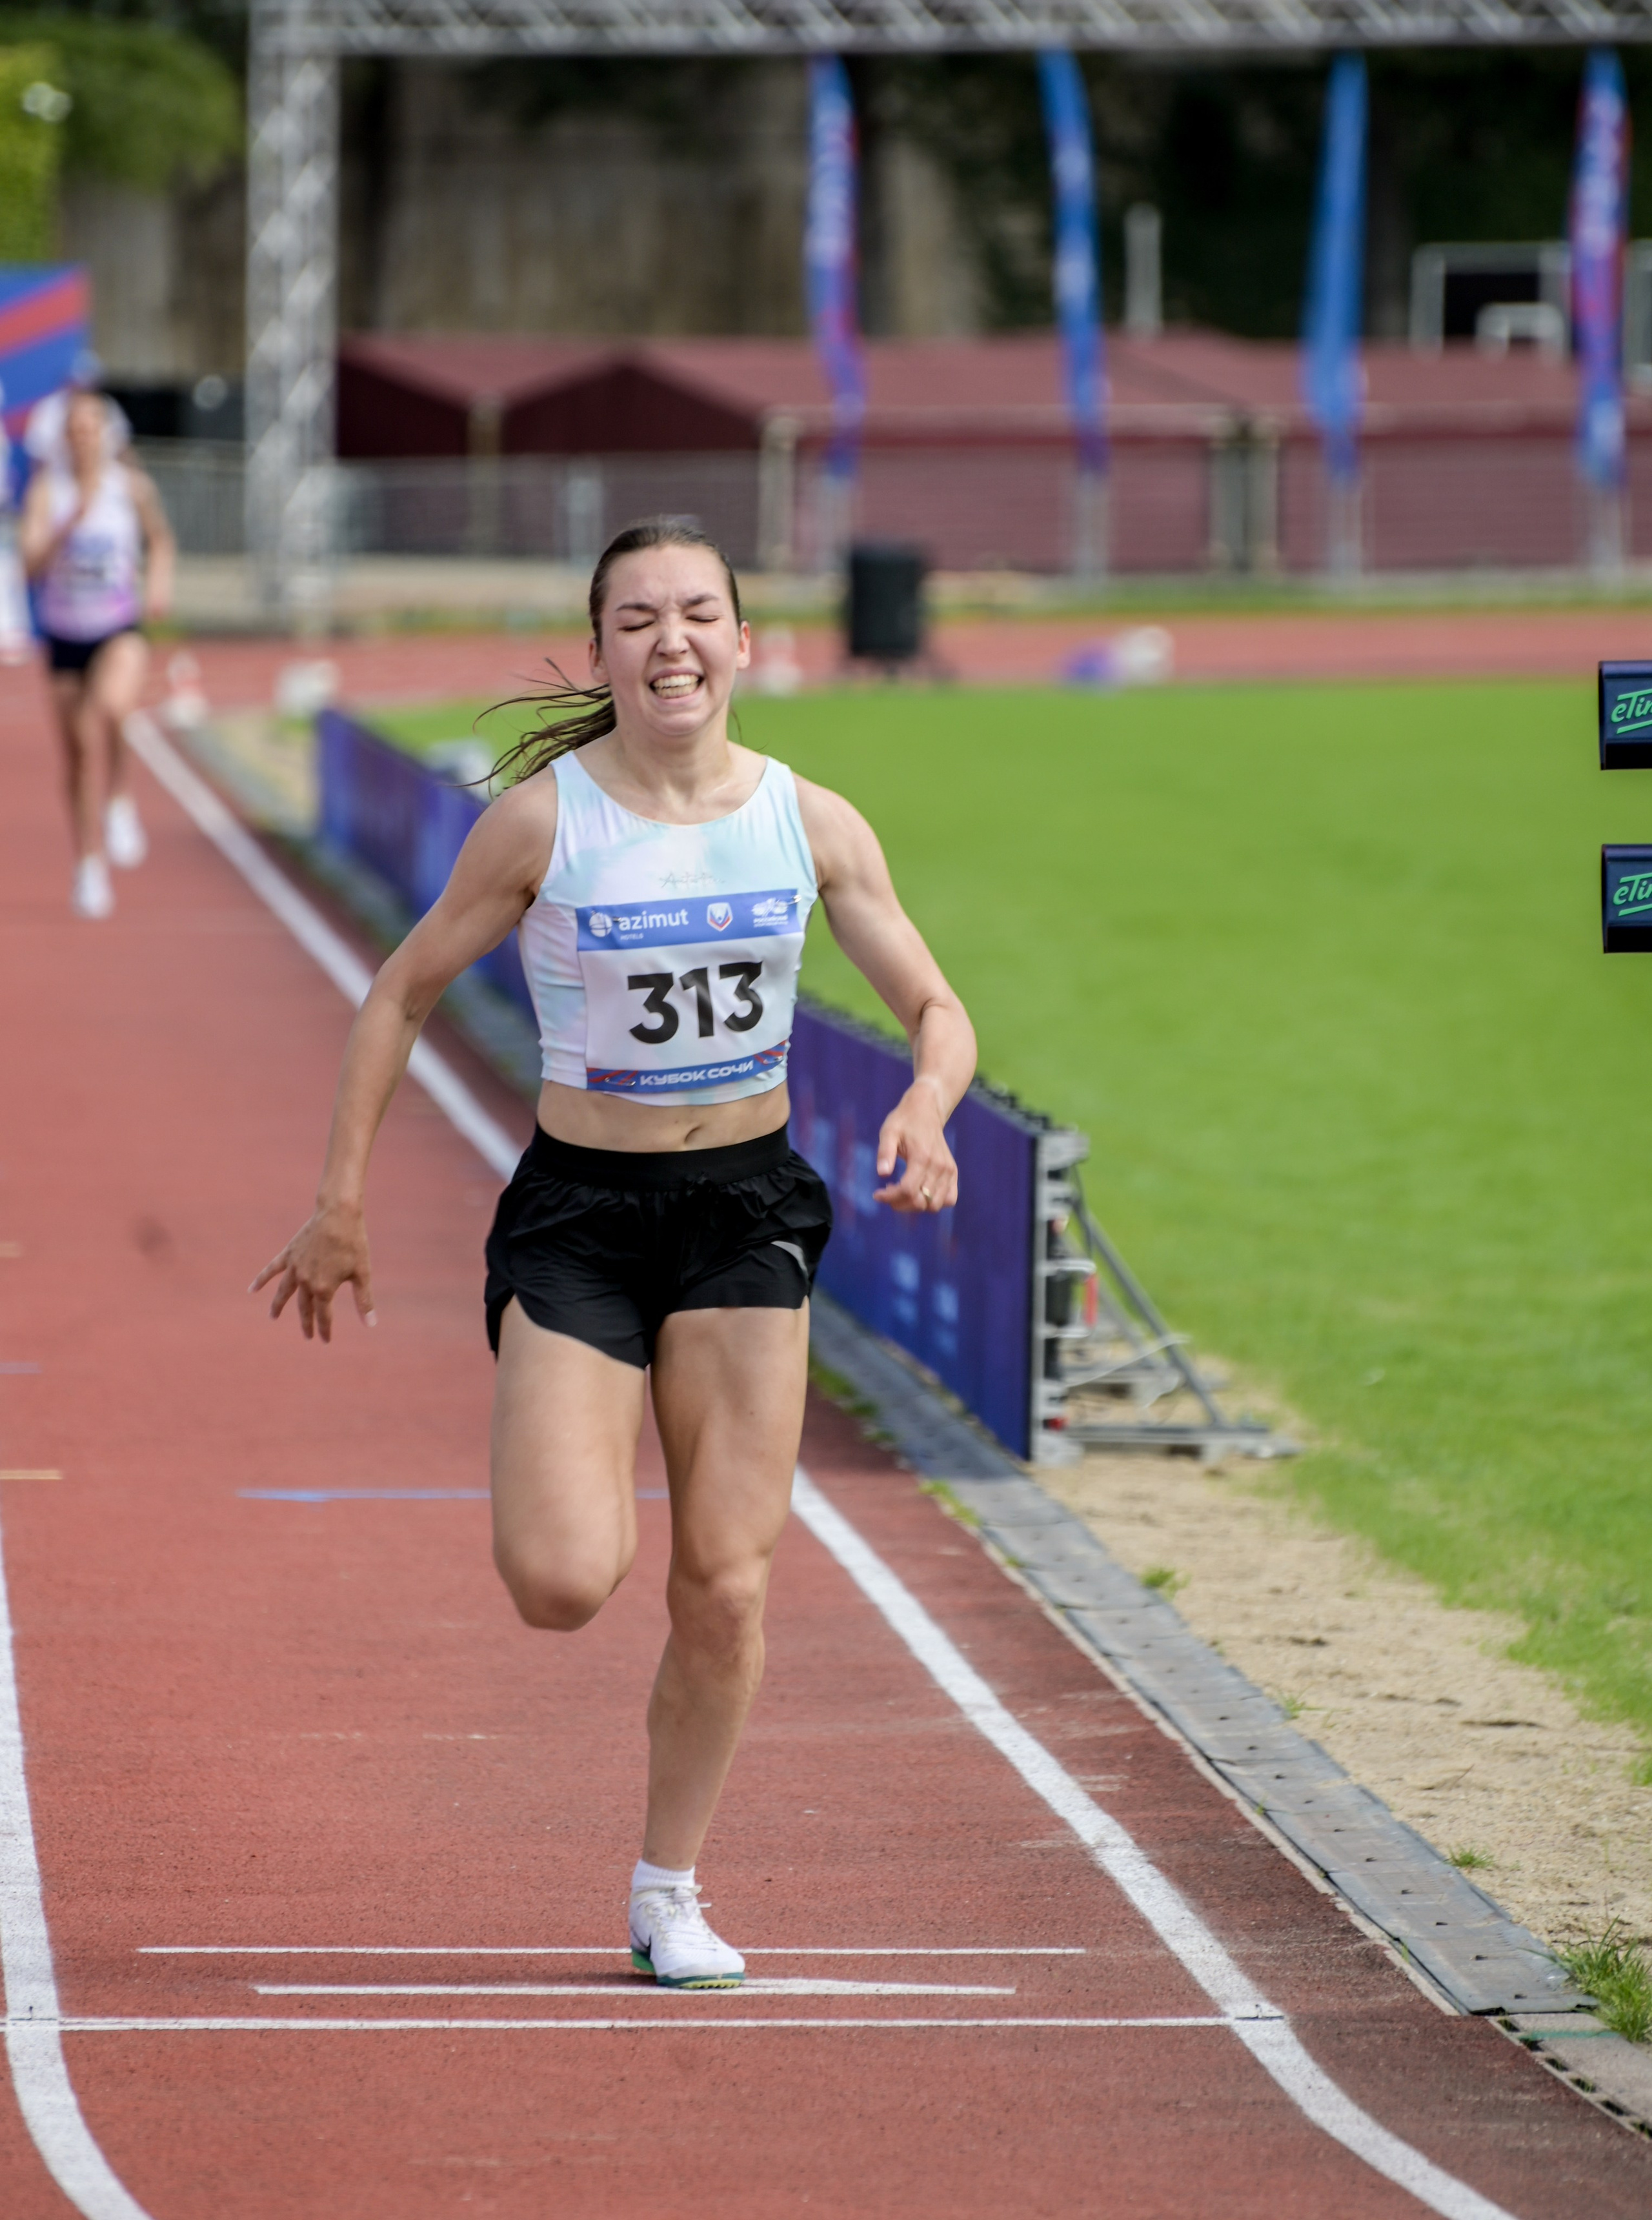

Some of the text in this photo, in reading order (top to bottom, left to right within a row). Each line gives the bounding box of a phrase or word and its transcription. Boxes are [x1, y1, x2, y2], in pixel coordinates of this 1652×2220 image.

[619, 909, 689, 931] azimut
[627, 960, 763, 1044] 313
[640, 1060, 754, 1085] КУБОК СОЧИ
